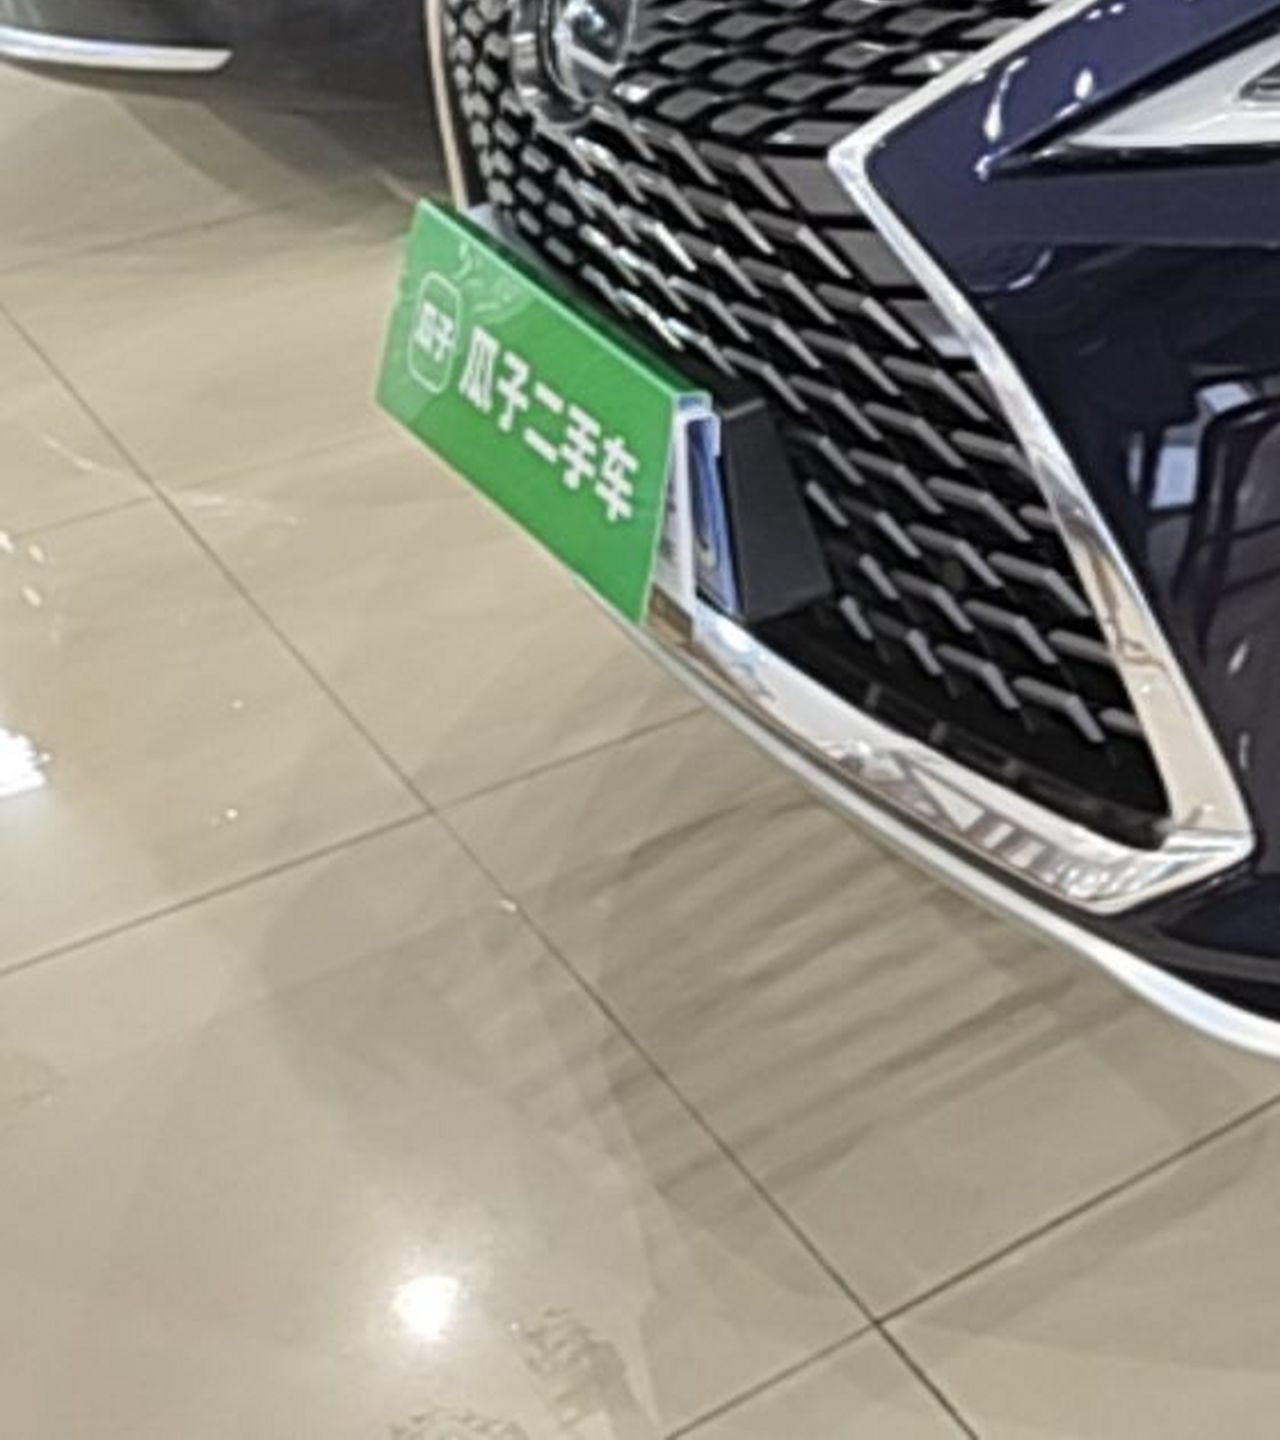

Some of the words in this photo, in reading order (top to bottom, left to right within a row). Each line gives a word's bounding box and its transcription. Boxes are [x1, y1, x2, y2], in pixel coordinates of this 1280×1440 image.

[458, 325, 641, 524] 瓜子二手车
